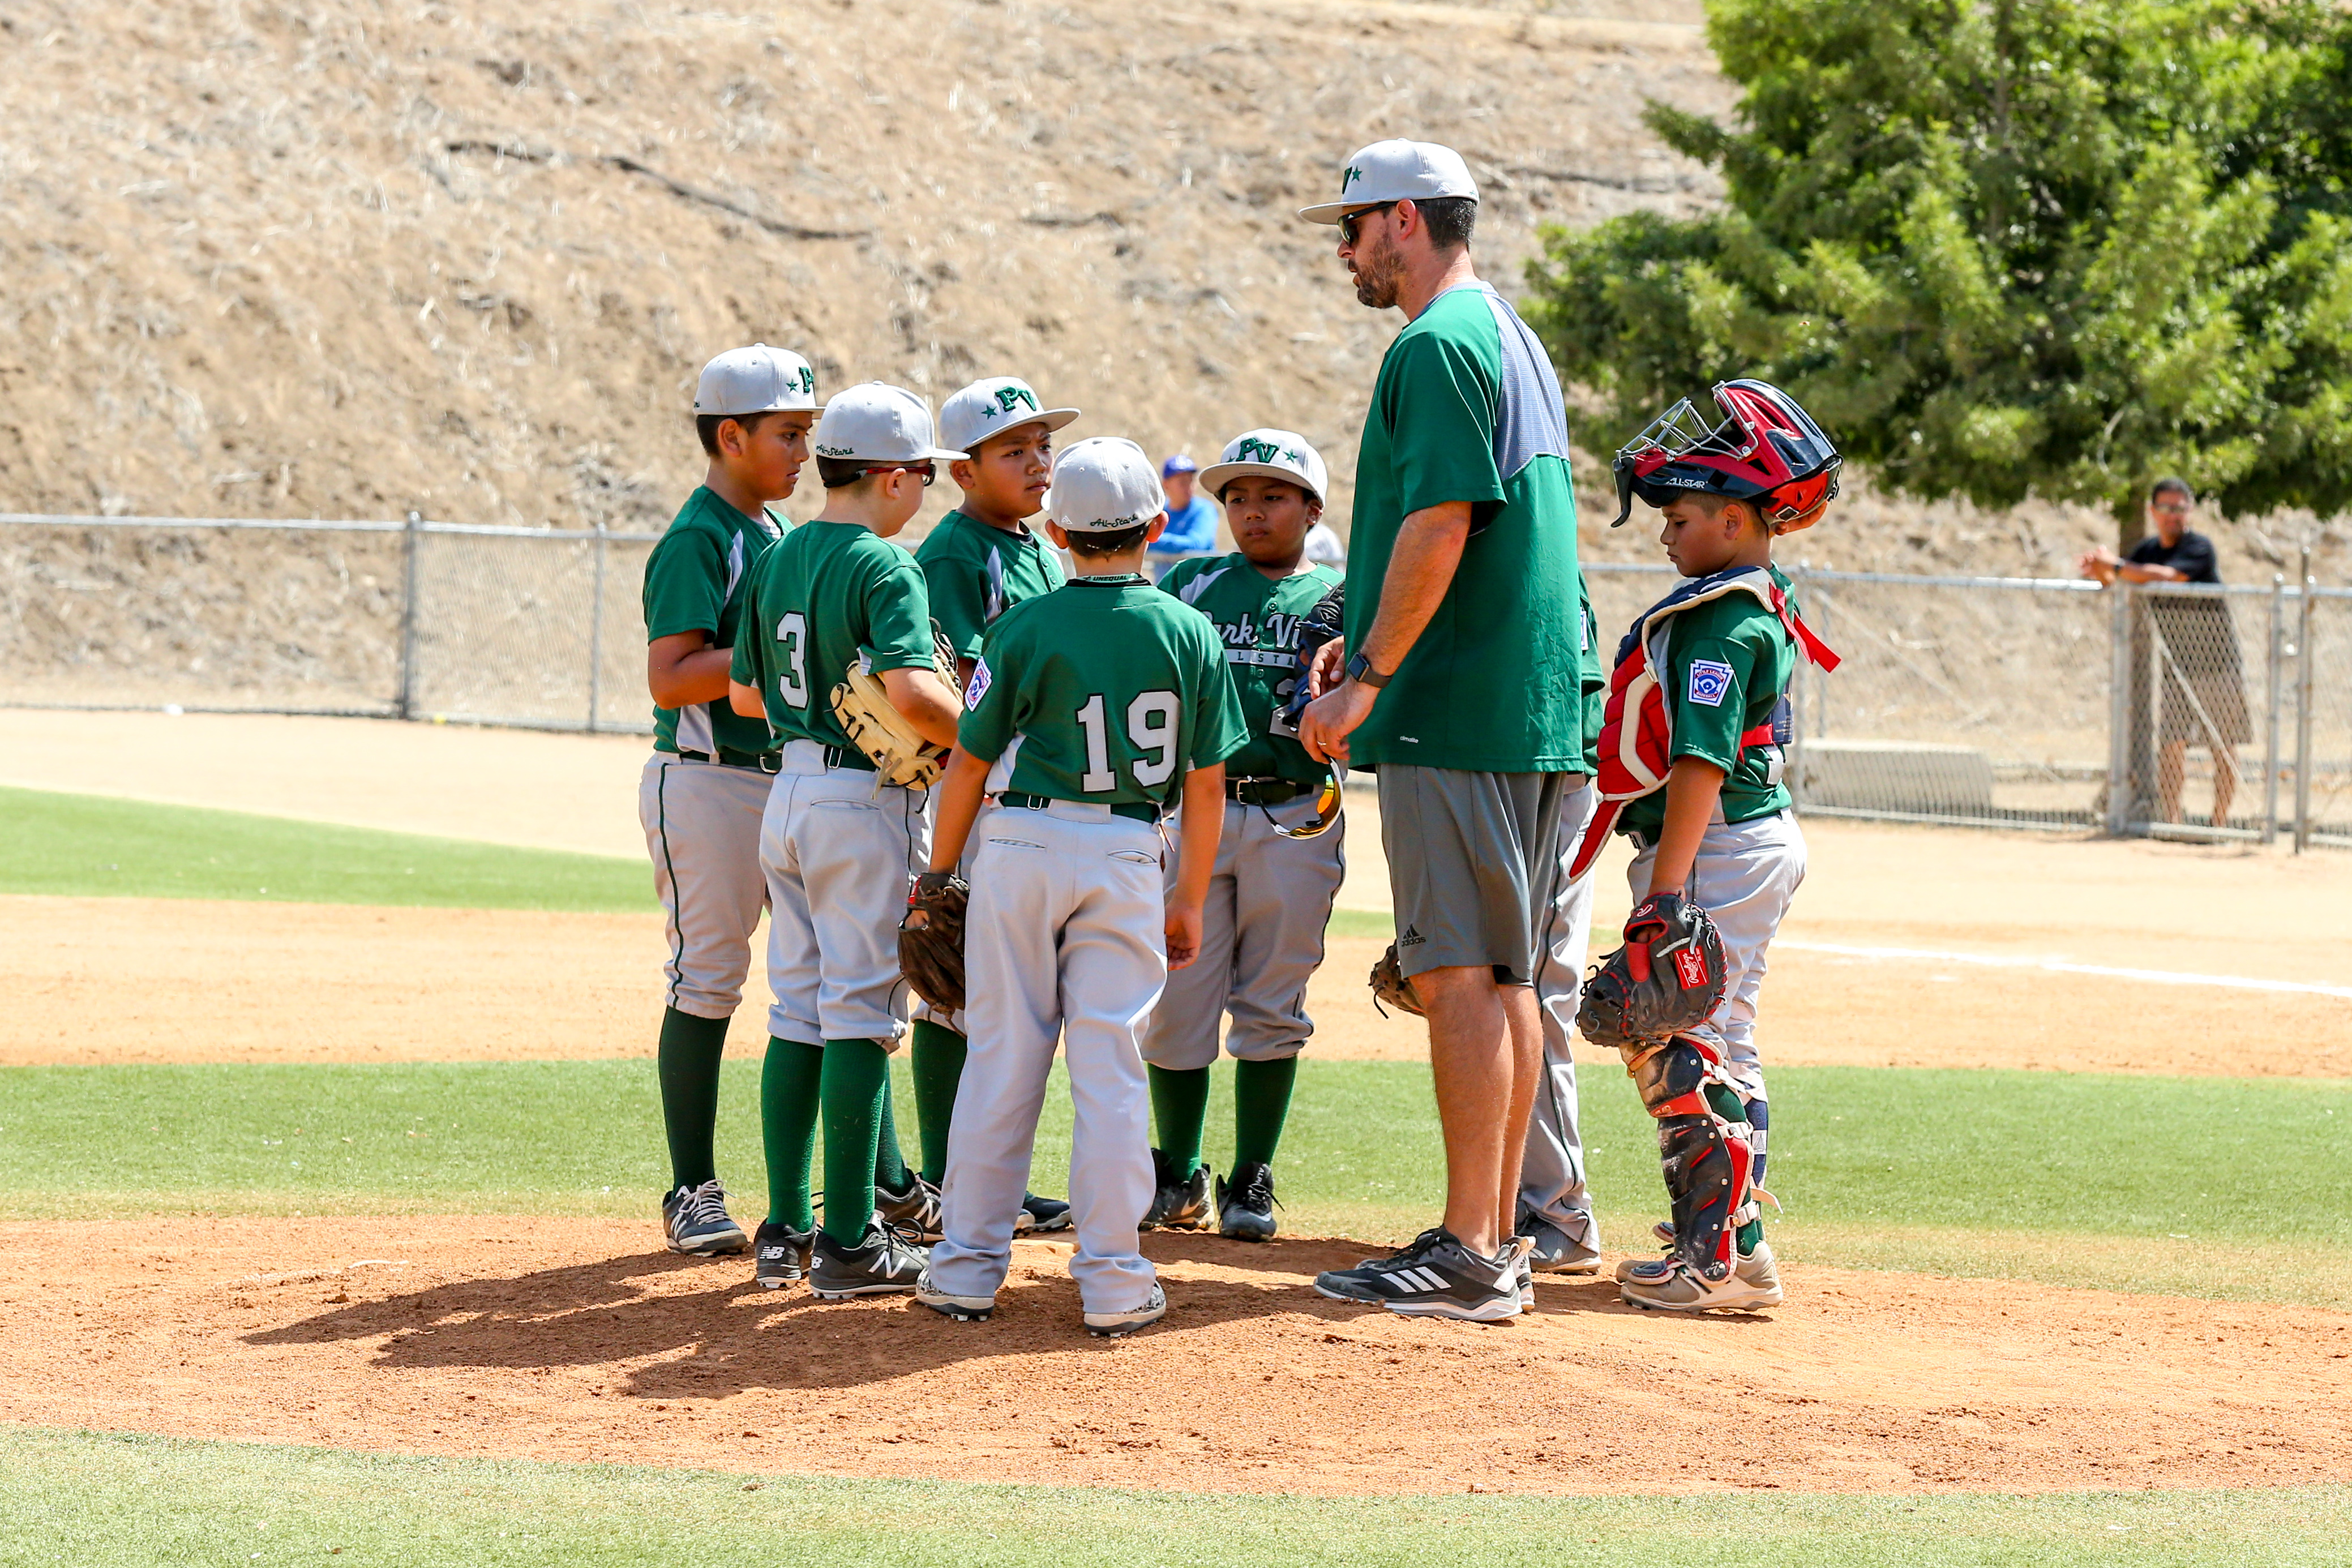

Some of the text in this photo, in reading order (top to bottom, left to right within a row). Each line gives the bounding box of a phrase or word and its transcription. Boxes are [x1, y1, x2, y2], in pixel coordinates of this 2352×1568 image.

[995, 385, 1037, 412] PV
[1236, 438, 1280, 464] PV
[1665, 477, 1705, 489] ALL-STAR
[1266, 613, 1301, 649] Vi
[777, 611, 809, 709] 3
[1076, 689, 1181, 792] 19
[1254, 1167, 1265, 1184] ALP
[759, 1246, 786, 1259] NB
